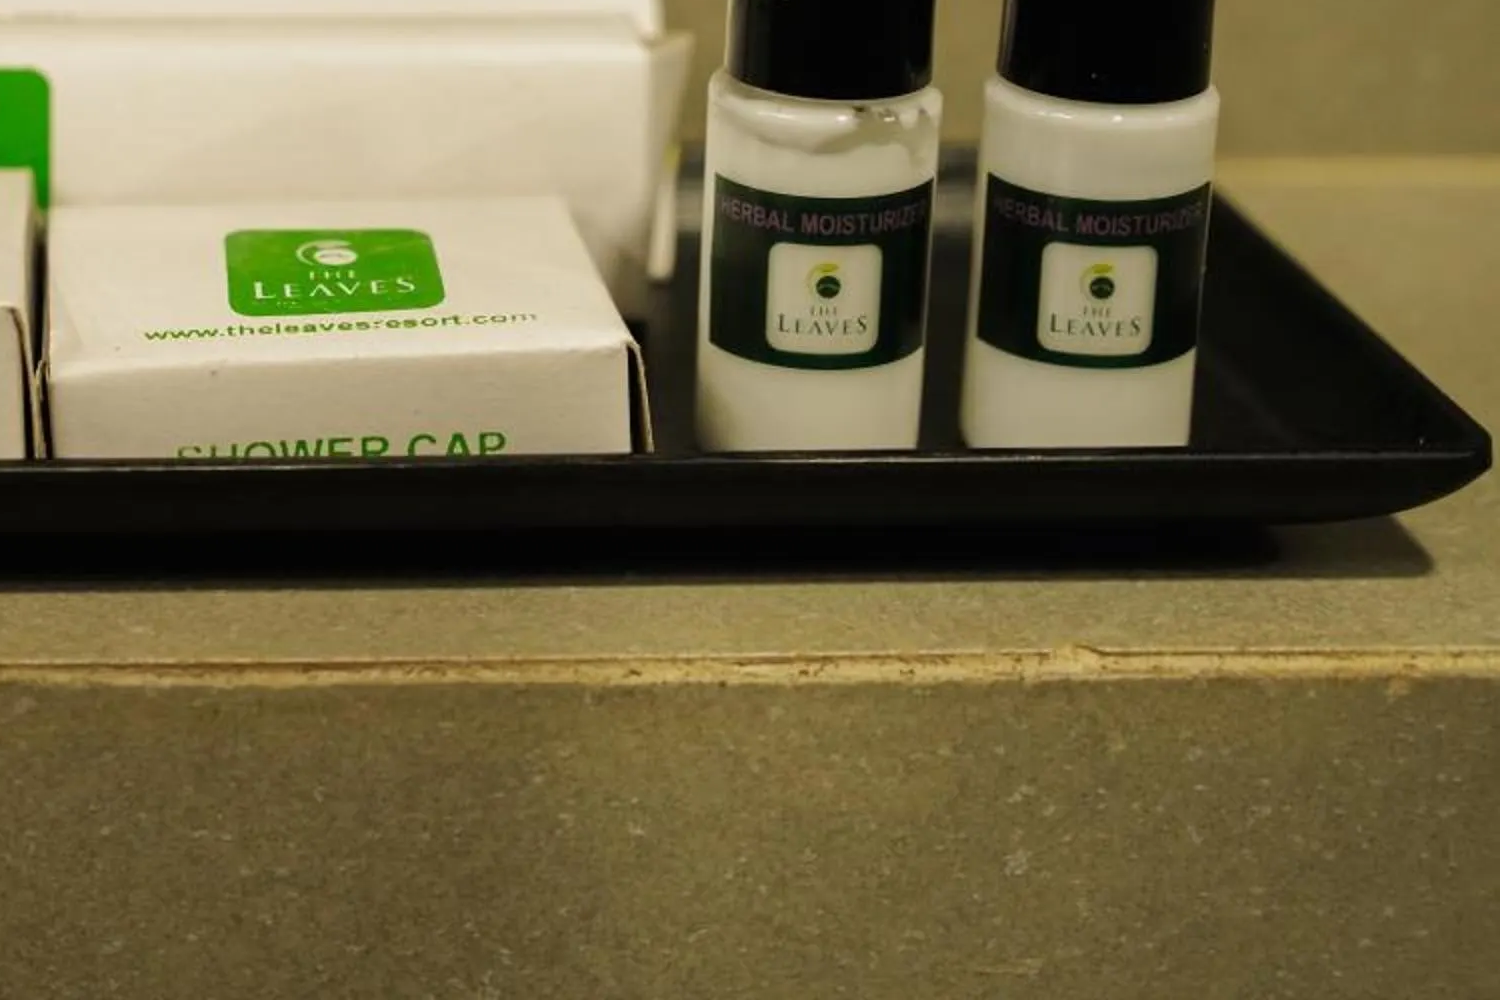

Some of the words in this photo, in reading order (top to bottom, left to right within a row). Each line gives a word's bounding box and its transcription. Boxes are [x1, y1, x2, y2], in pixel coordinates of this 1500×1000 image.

[720, 196, 795, 233] HERBAL
[252, 276, 417, 300] LEAVES
[143, 312, 538, 342] www.theleavesresort.com
[777, 313, 869, 336] LEAVES
[1049, 313, 1142, 337] LEAVES
[406, 431, 507, 457] CAP
